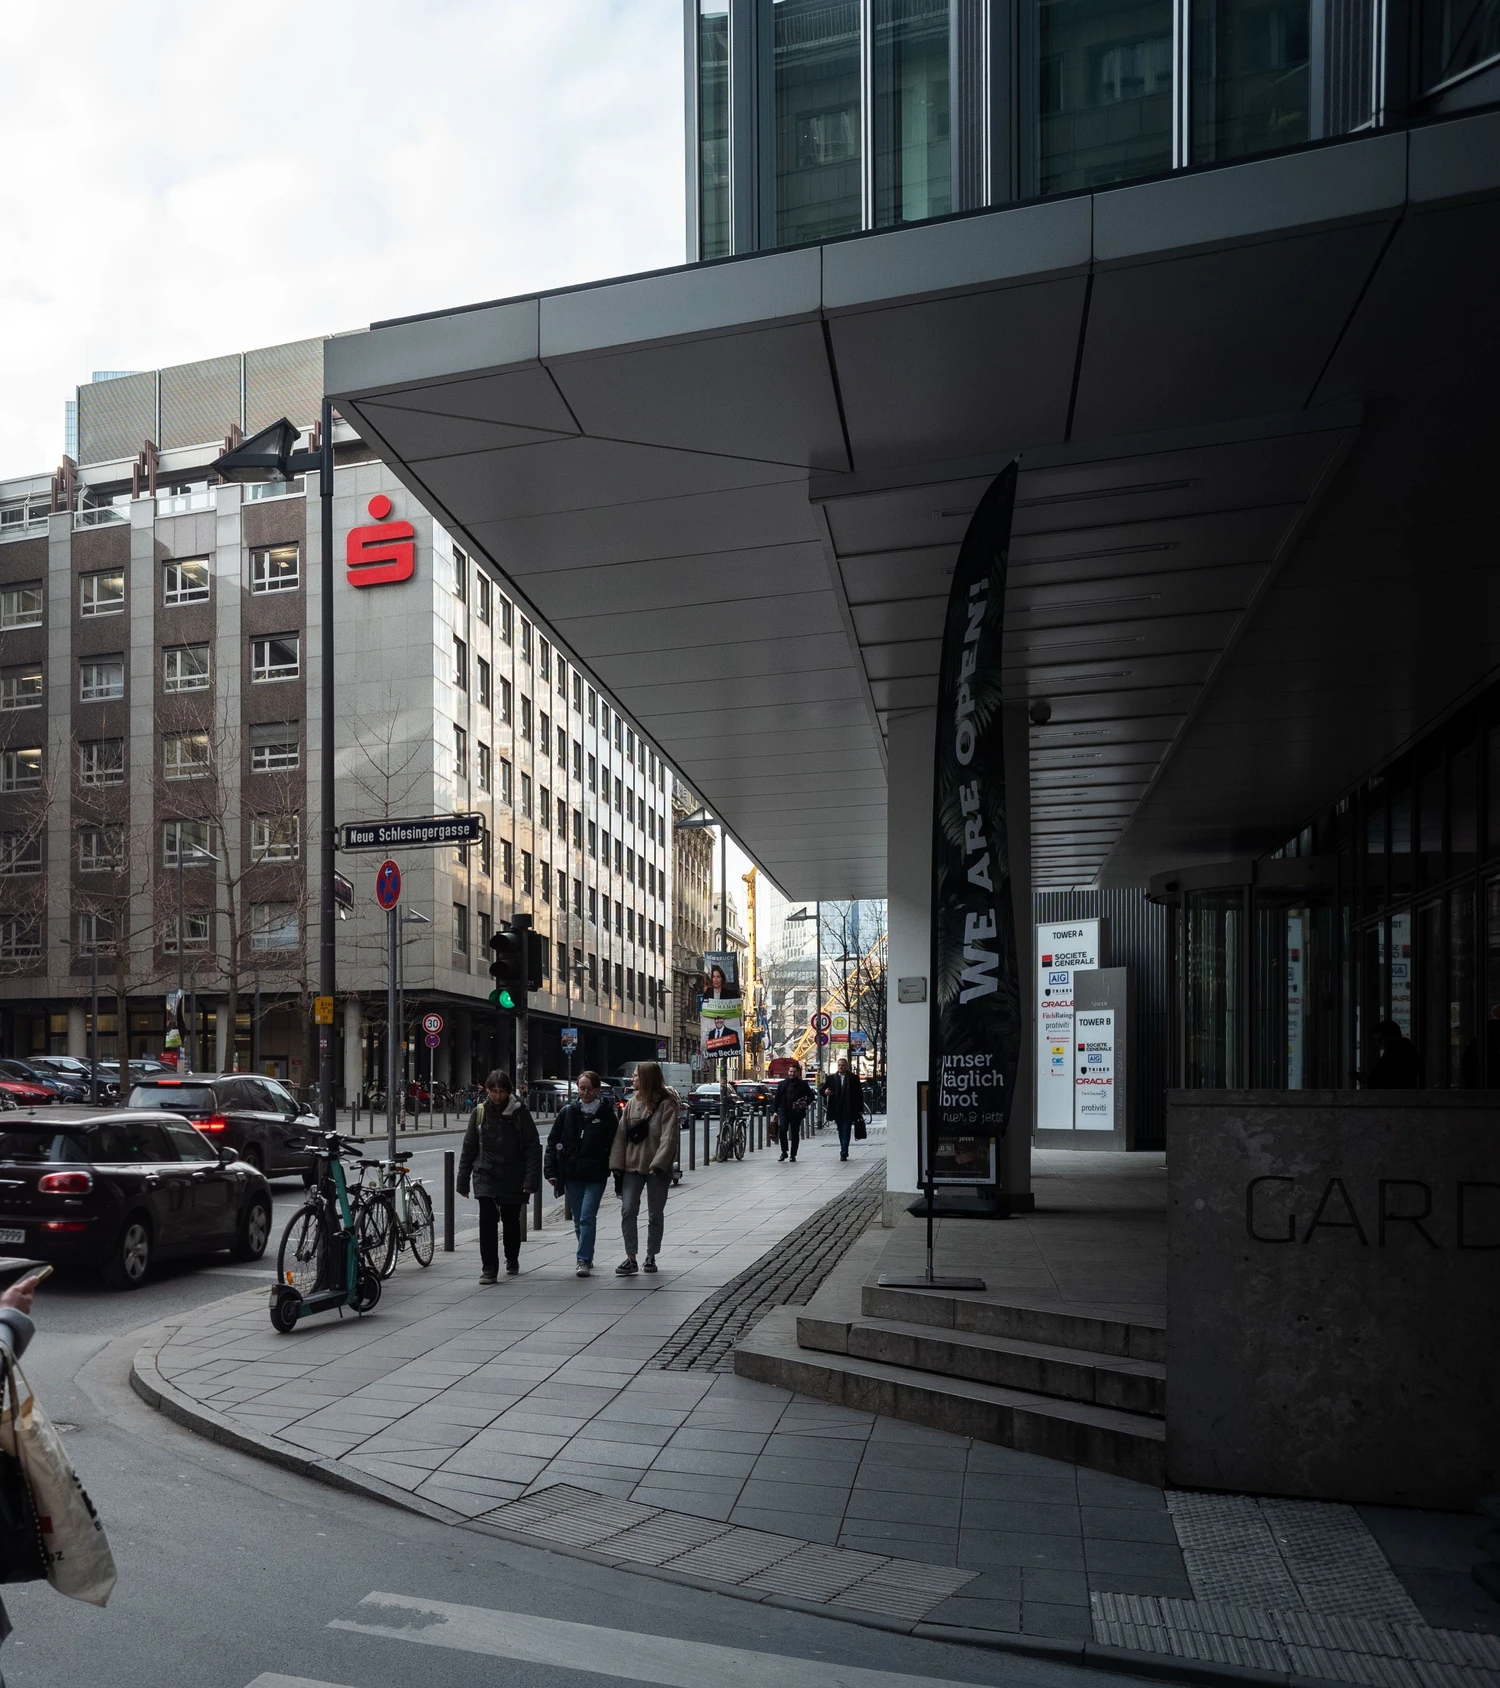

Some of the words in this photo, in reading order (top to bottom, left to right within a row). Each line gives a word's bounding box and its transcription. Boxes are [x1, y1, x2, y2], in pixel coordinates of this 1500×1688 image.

[954, 576, 990, 766] OPEN!
[350, 830, 374, 843] Neue
[379, 824, 470, 842] Schlesingergasse
[958, 779, 994, 893] ARE
[1052, 930, 1077, 939] TOWER
[1078, 929, 1083, 937] A
[959, 908, 999, 1005] WE
[1054, 951, 1087, 960] SOCIETE
[1054, 958, 1095, 967] GENERALE
[1051, 974, 1066, 982] AIG
[427, 1019, 438, 1028] 30
[1046, 1022, 1070, 1031] protiviti
[1079, 1018, 1104, 1026] TOWER
[1106, 1017, 1111, 1025] B
[703, 1051, 717, 1059] Uwe
[718, 1048, 741, 1057] Becker
[943, 1053, 993, 1067] unser
[943, 1069, 1004, 1092] täglich
[942, 1090, 979, 1107] brot
[1081, 1104, 1107, 1113] protiviti
[943, 1111, 967, 1122] hier
